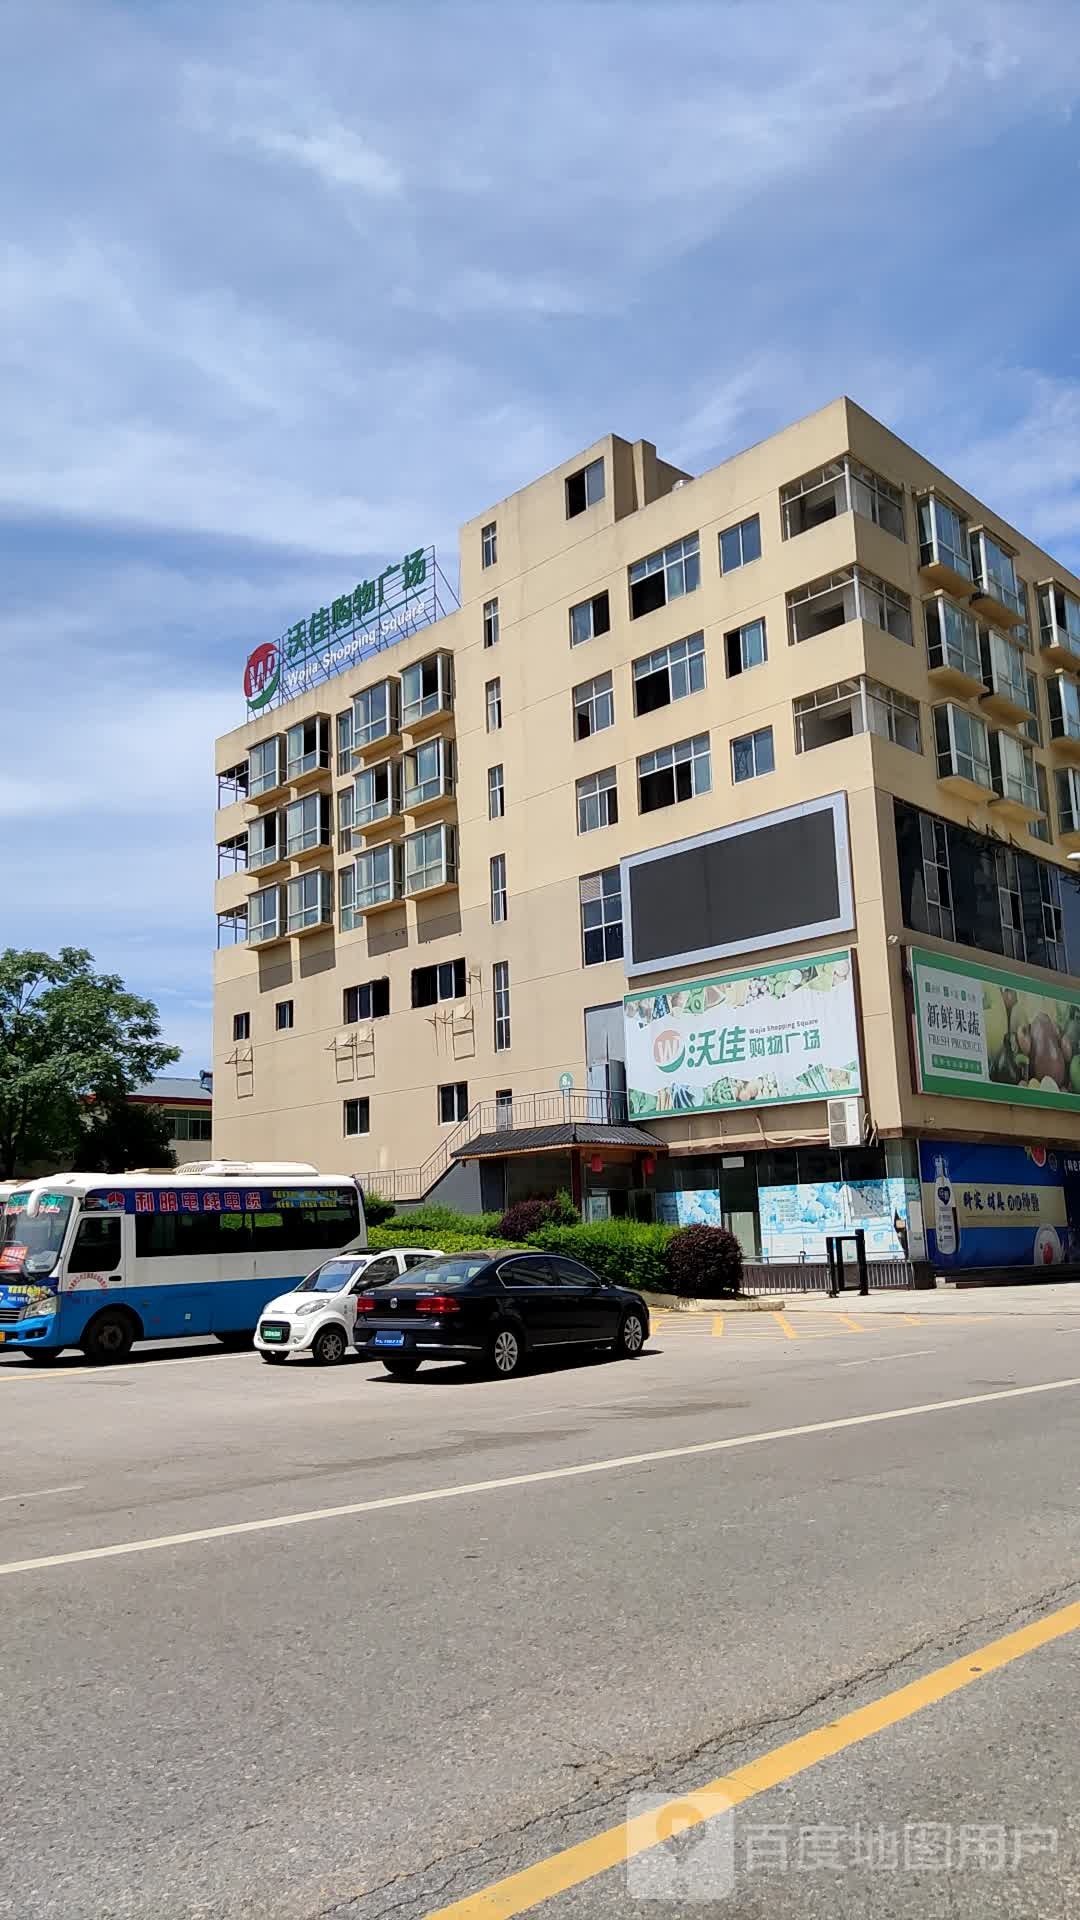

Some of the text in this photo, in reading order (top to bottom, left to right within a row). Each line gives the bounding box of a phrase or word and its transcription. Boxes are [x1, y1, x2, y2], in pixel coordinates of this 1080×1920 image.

[287, 548, 426, 657] 沃佳购物广场
[287, 602, 426, 687] Wojia Shopping Square
[749, 1018, 818, 1035] Wojia Shopping Square
[927, 1002, 981, 1036] 新鲜果蔬
[687, 1026, 821, 1068] 沃佳 购物广场
[928, 1034, 950, 1047] FRESH
[135, 1191, 263, 1212] 利明电线电缆
